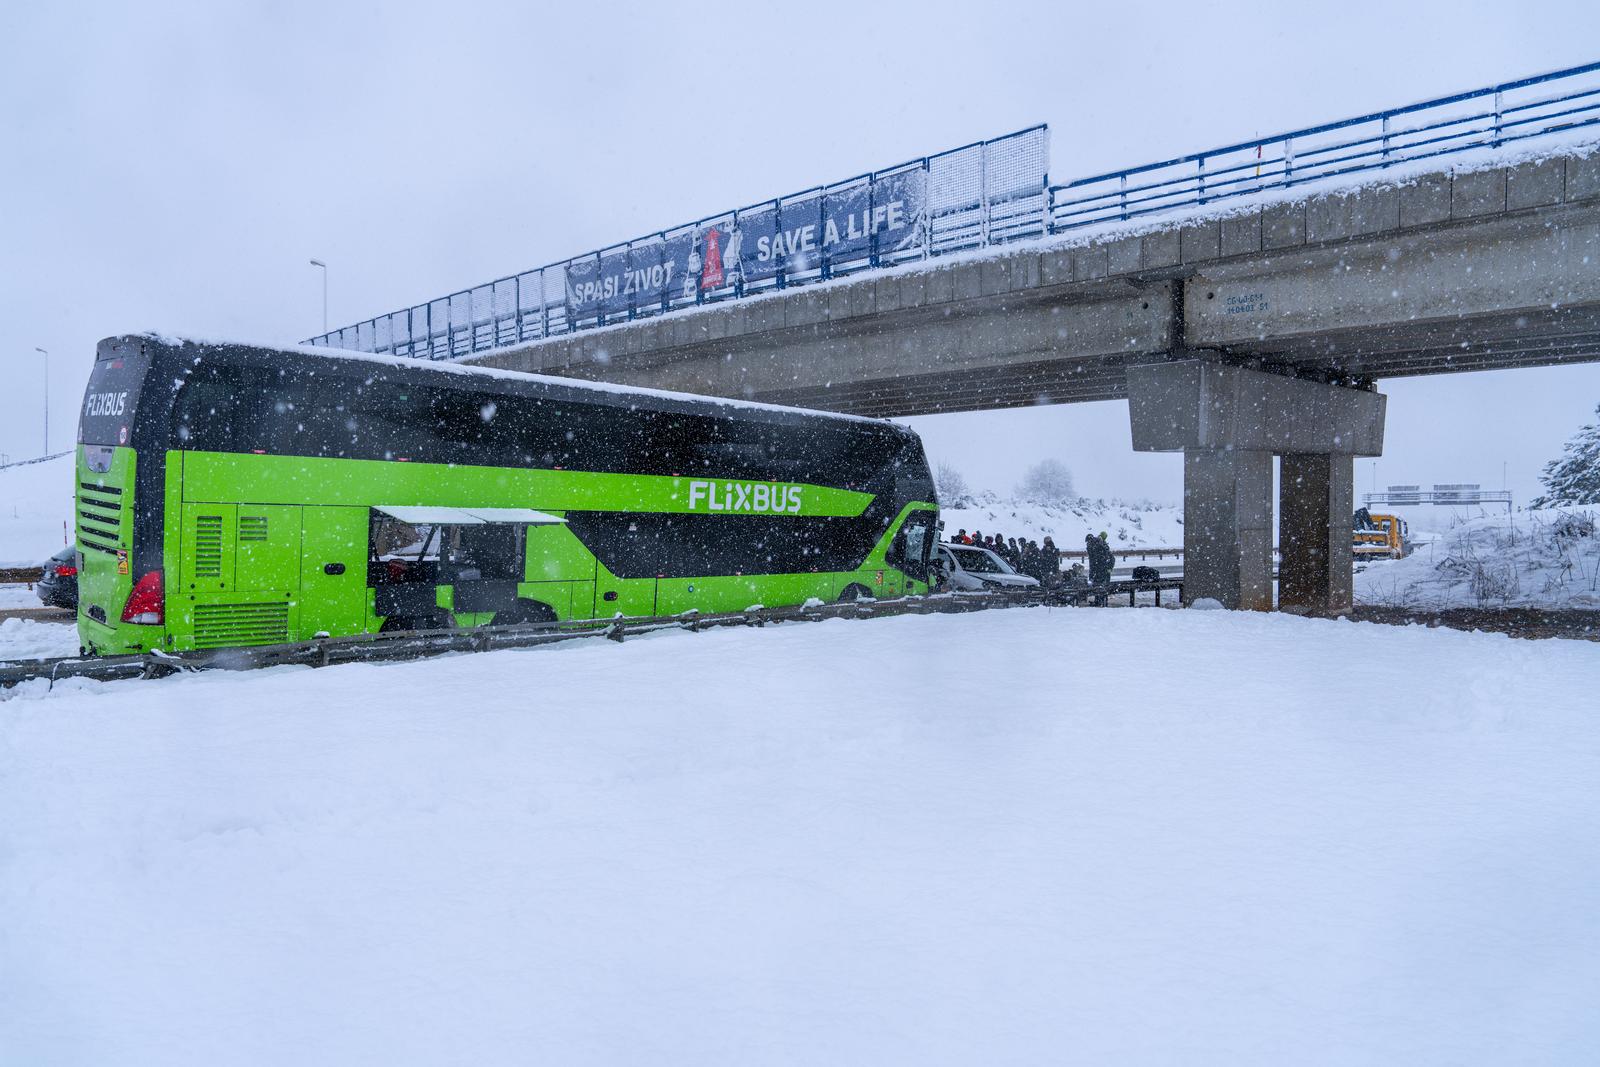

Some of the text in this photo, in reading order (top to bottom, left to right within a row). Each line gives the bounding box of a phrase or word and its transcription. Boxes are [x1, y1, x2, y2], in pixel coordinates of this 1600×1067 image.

[757, 201, 904, 262] SAVE A LIFE
[575, 261, 675, 303] SPASI ŽIVOT
